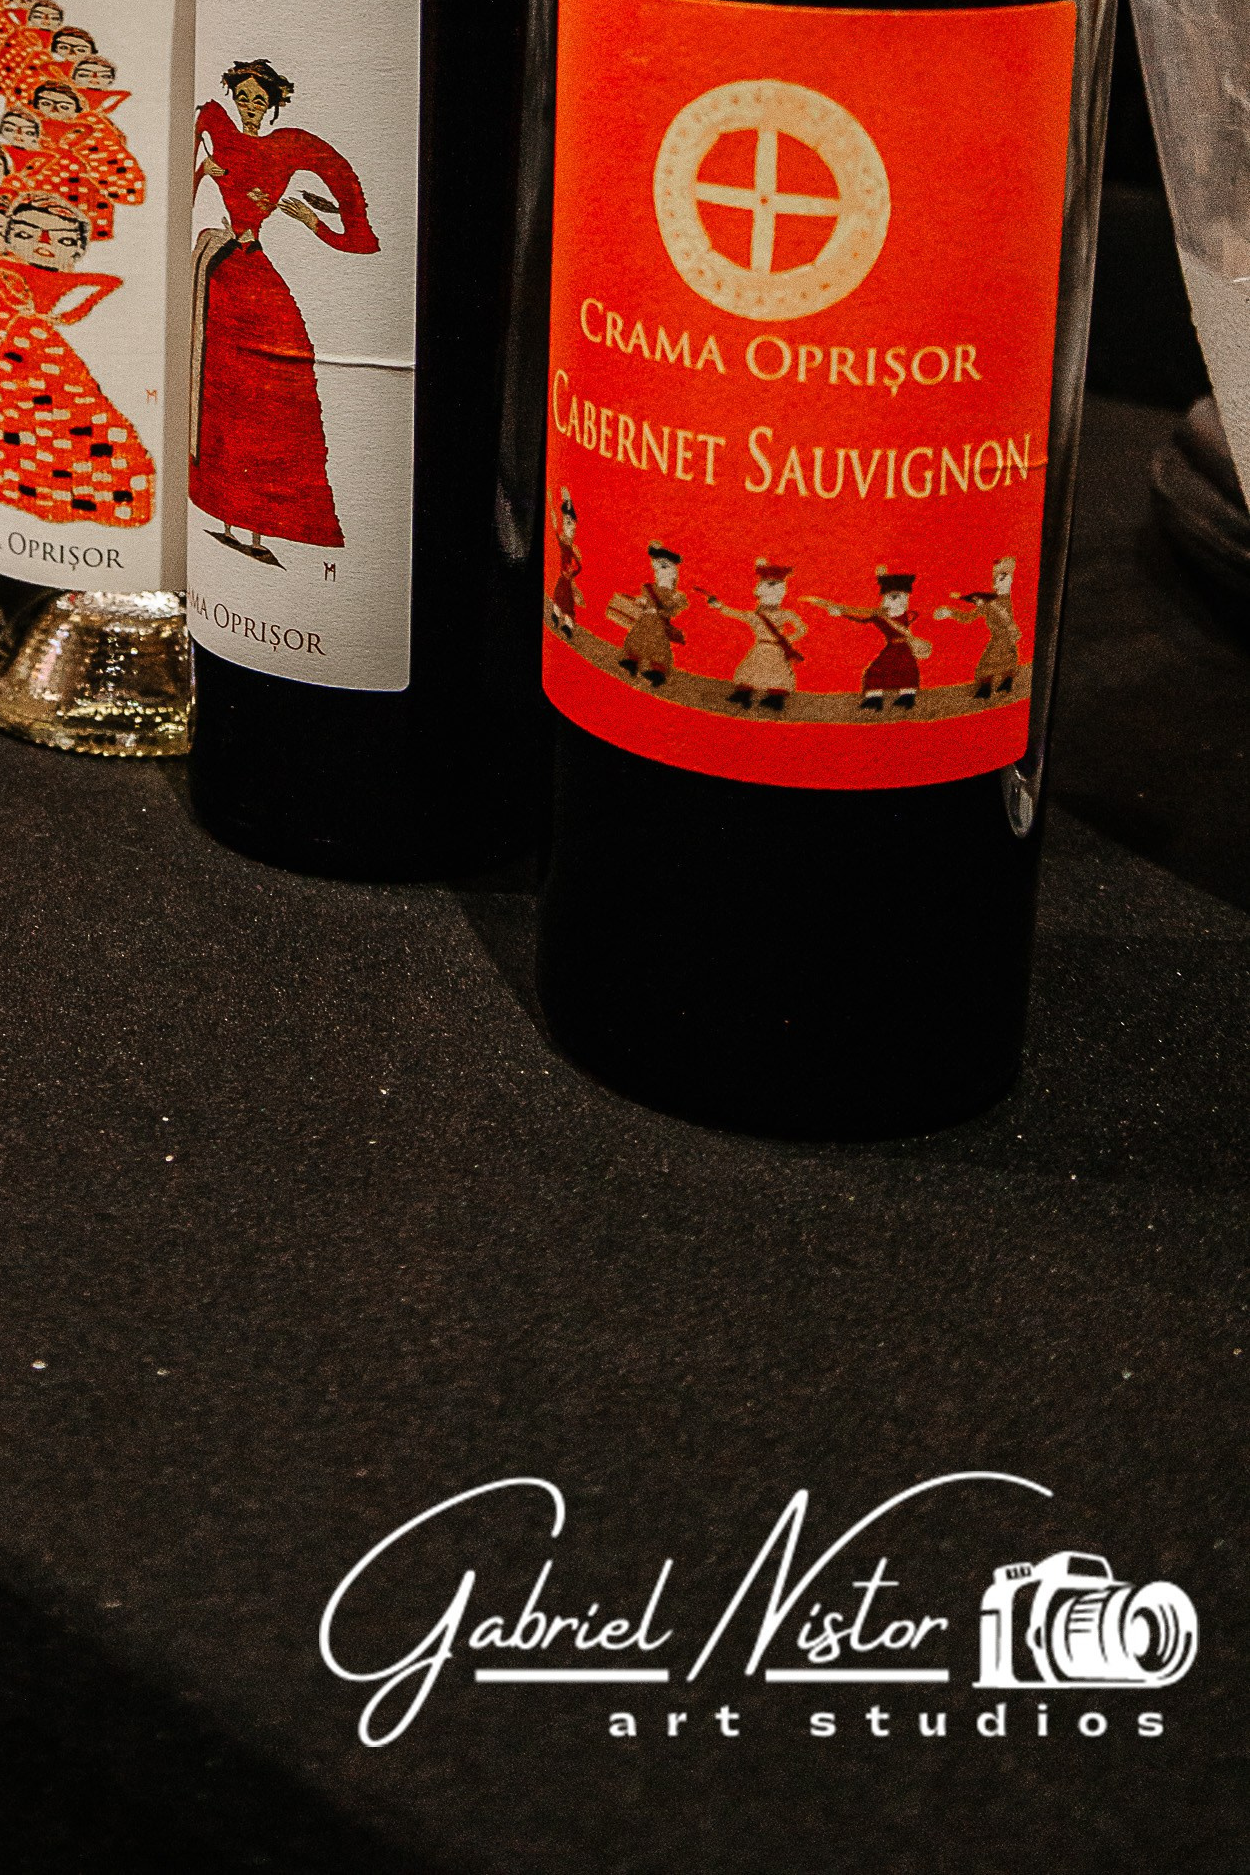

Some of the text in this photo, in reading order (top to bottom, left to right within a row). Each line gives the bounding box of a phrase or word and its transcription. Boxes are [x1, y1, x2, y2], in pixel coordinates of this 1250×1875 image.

[579, 296, 727, 375] CRAMA
[551, 368, 1034, 501] CABERNET SAUVIGNON
